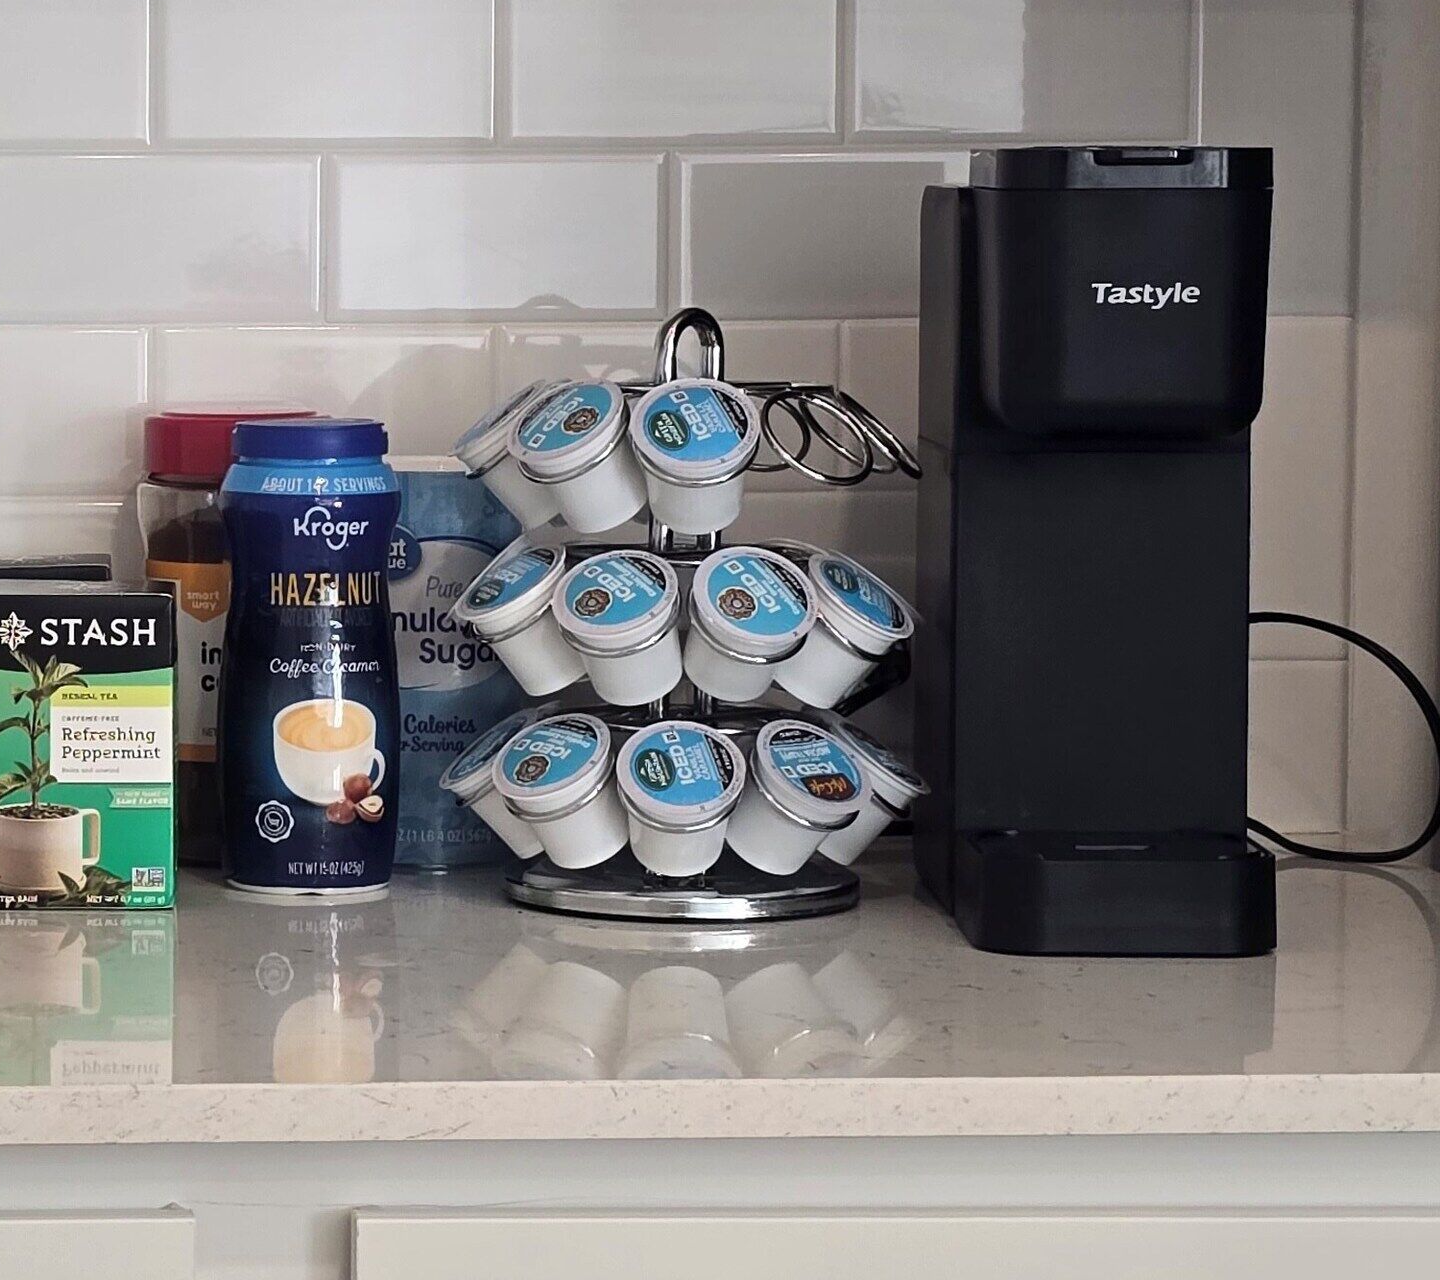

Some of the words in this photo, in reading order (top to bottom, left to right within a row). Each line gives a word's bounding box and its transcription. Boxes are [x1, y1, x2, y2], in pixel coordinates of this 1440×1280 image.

[1091, 282, 1200, 309] Tastyle
[680, 403, 711, 441] ICED
[261, 477, 303, 491] ABOUT
[334, 477, 387, 491] SERVINGS
[293, 506, 369, 550] Kroger
[270, 572, 380, 606] HAZELNUT
[426, 575, 463, 598] Pure
[597, 573, 636, 602] ICED
[741, 573, 780, 613] ICED
[40, 618, 157, 646] STASH
[419, 638, 499, 670] Suga
[270, 658, 318, 679] Coffee
[62, 727, 156, 744] Refreshing
[404, 714, 477, 734] Calories
[62, 745, 161, 762] Peppermint
[529, 741, 572, 760] ICED
[669, 745, 696, 785] ICED
[797, 761, 838, 776] ICED
[288, 862, 303, 874] NET
